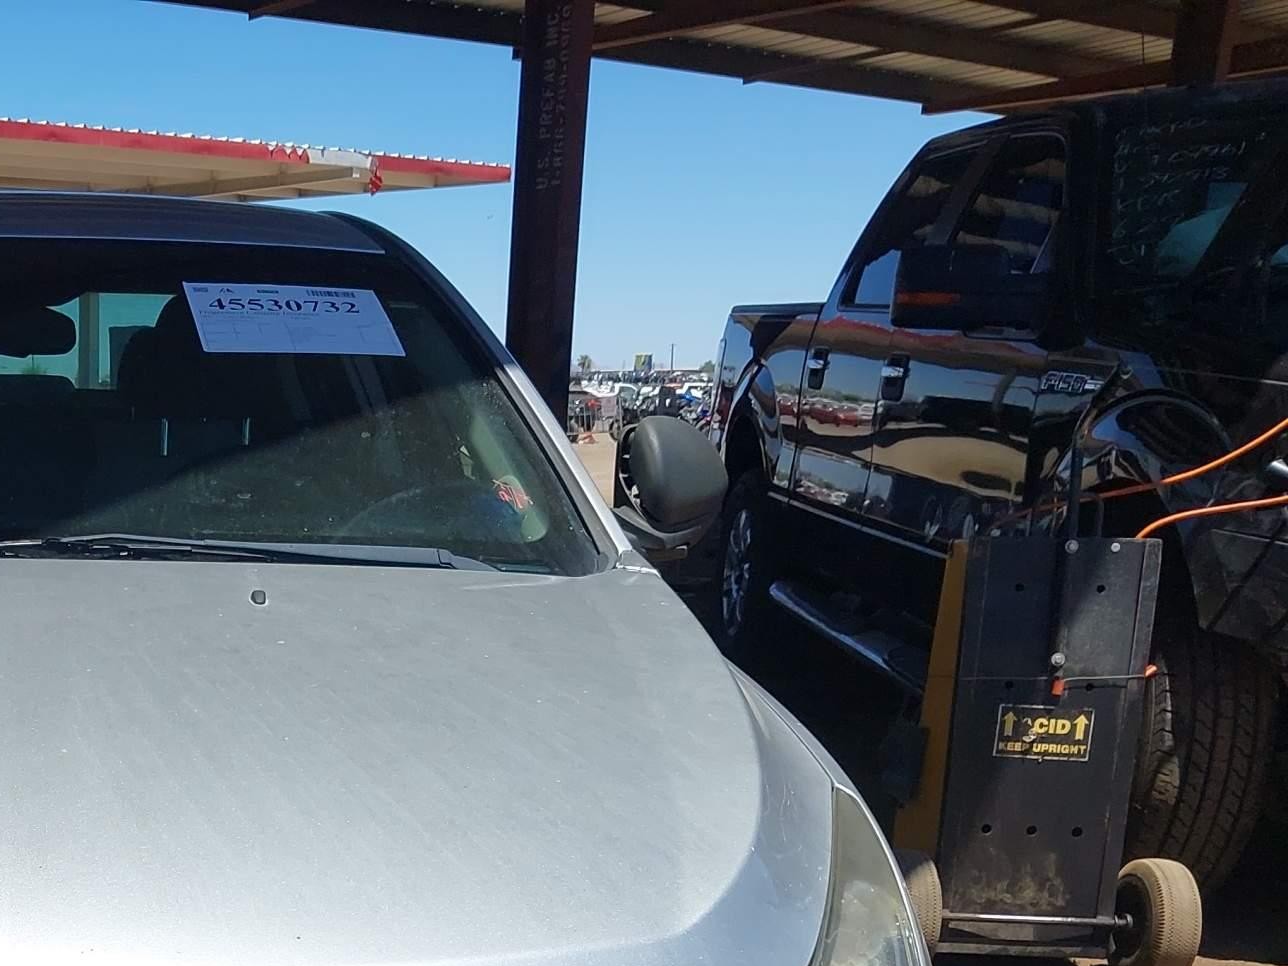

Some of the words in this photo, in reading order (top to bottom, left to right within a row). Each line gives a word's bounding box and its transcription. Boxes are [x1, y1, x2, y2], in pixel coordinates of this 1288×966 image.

[208, 297, 360, 314] 45530732
[998, 741, 1030, 752] KEEP
[1032, 742, 1087, 755] UPRIGHT
